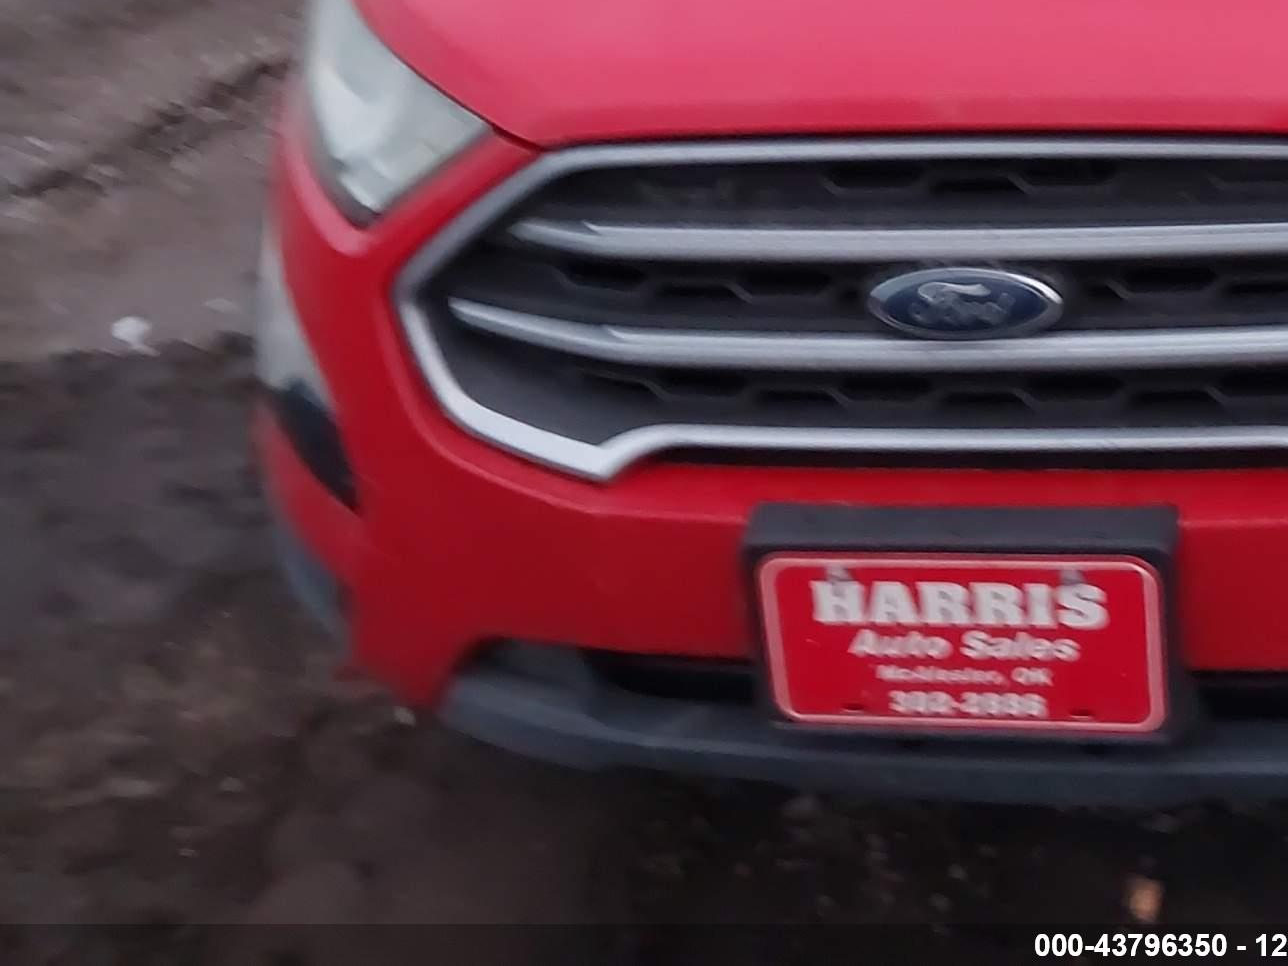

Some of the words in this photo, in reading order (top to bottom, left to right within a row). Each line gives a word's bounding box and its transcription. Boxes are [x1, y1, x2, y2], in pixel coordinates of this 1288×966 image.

[811, 580, 1108, 630] HARRIS
[848, 629, 951, 659] Auto
[959, 629, 1081, 661] Sales
